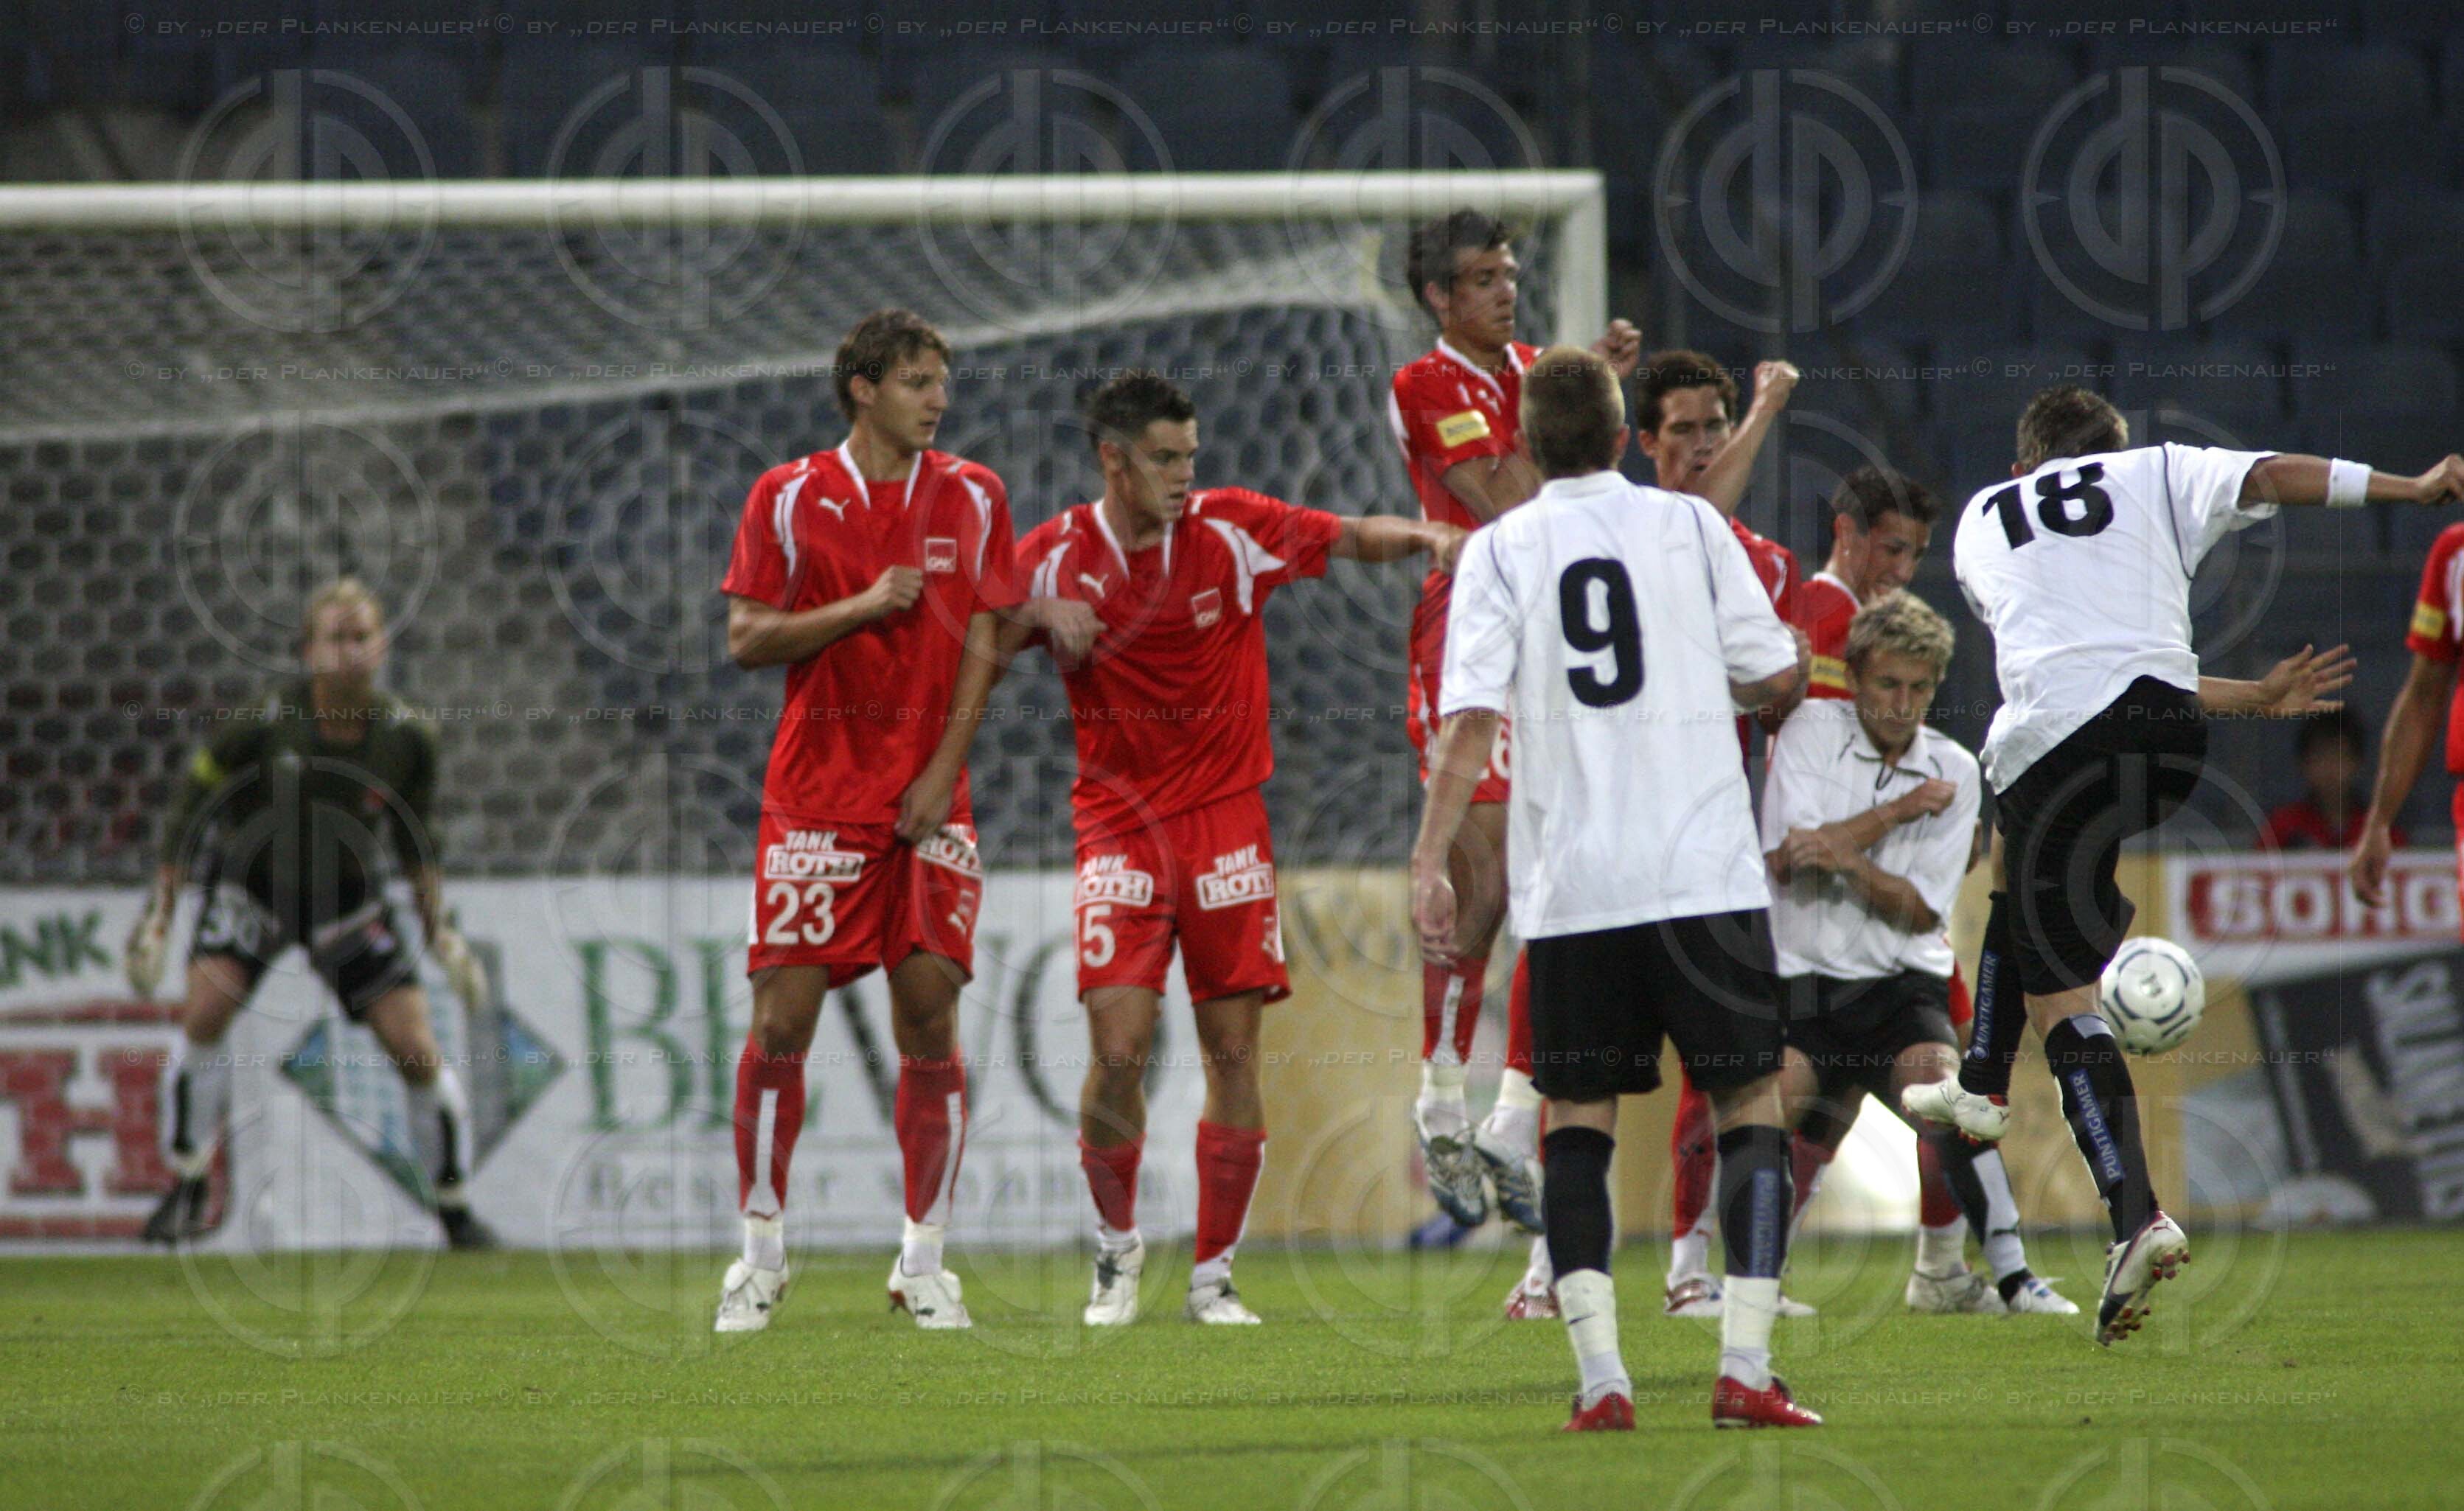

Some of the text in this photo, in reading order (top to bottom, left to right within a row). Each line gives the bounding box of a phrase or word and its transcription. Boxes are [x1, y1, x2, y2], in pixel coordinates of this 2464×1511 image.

[1982, 461, 2114, 550] 18
[1559, 557, 1645, 709] 9
[785, 830, 838, 851] TANK
[1215, 844, 1259, 877] TANK
[765, 882, 835, 944] 23
[1079, 874, 1146, 901] OTH
[1083, 904, 1116, 968] 5
[2073, 1071, 2121, 1181] PUNTIGAMER
